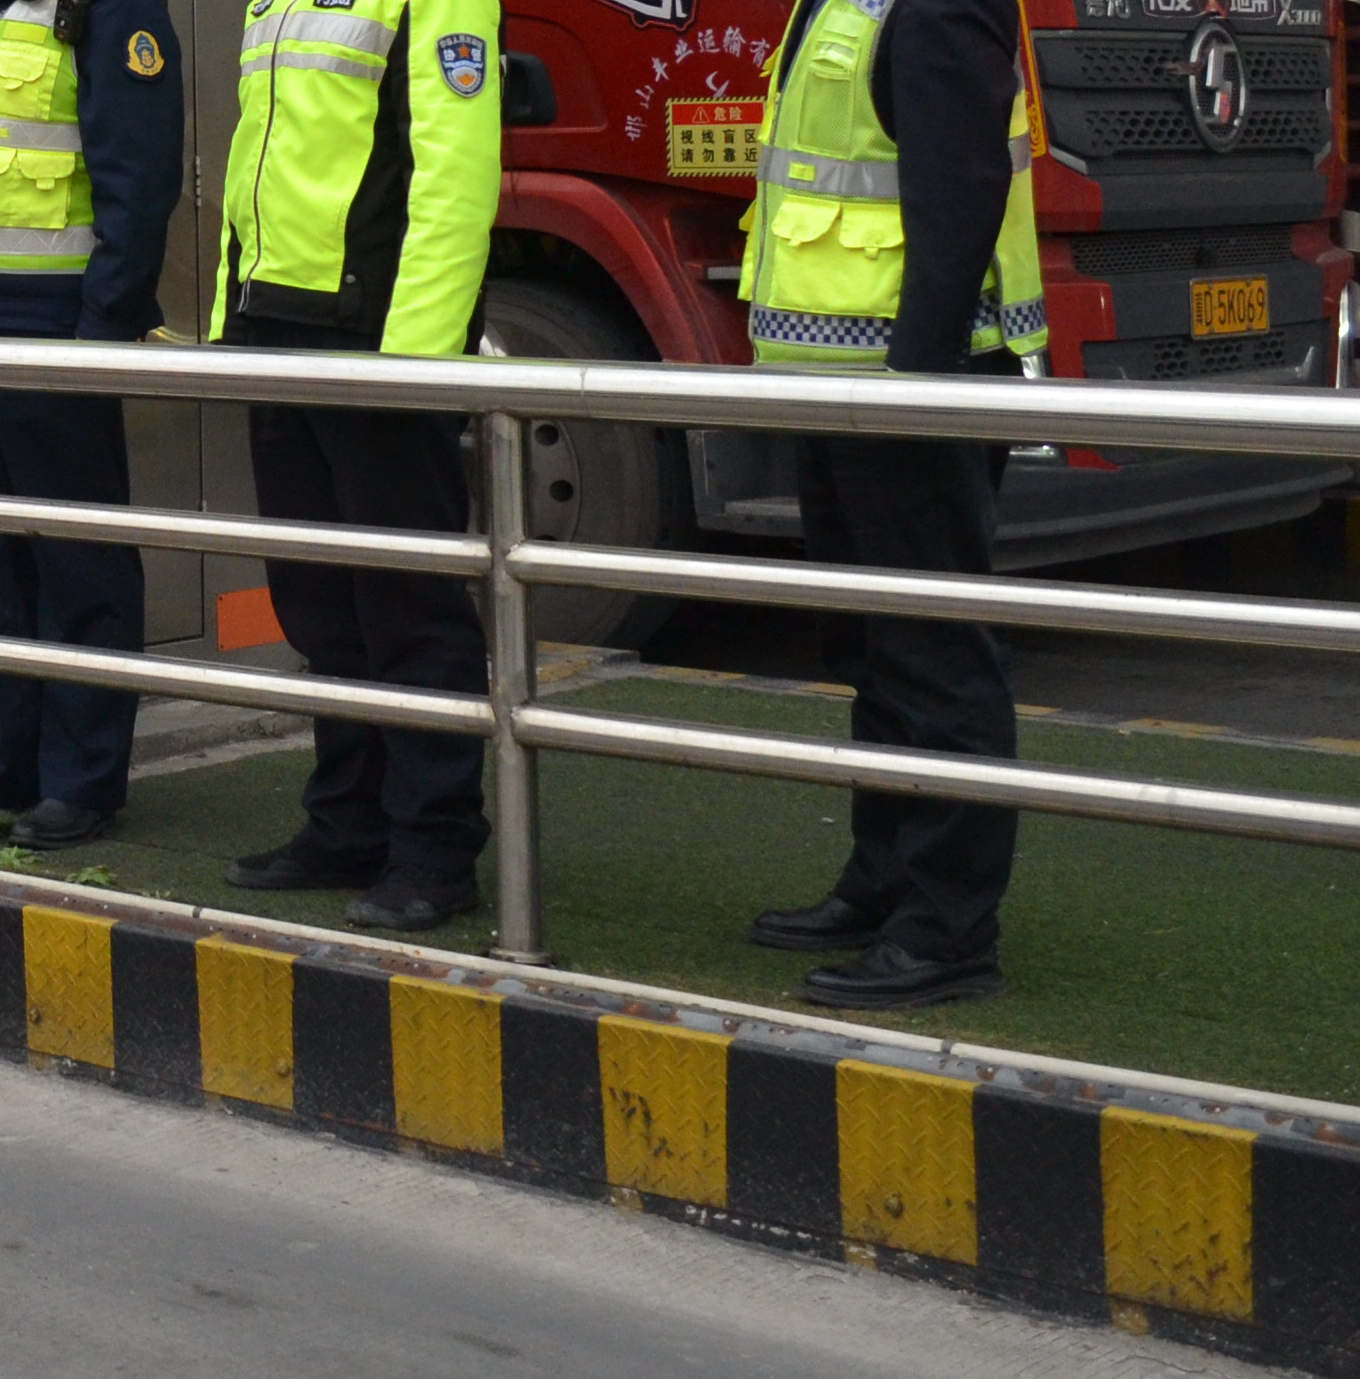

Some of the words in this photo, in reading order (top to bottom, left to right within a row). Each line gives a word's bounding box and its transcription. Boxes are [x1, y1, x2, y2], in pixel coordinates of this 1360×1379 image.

[714, 107, 742, 121] 危险
[681, 129, 757, 144] 视线盲区
[681, 148, 758, 163] 请勿靠近
